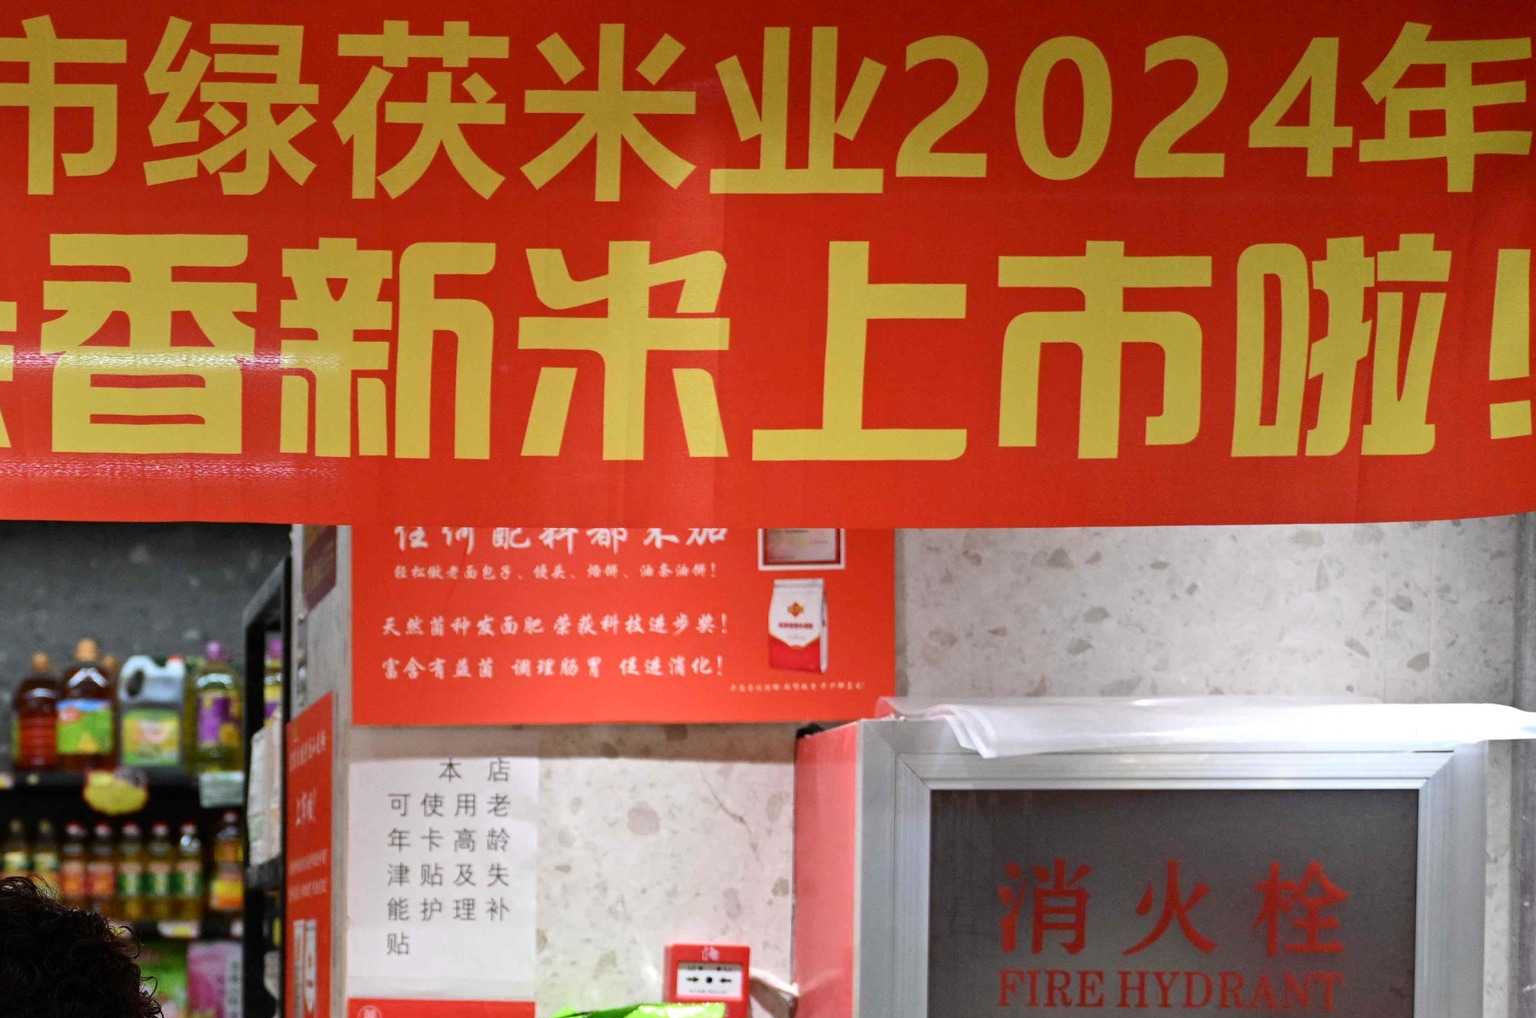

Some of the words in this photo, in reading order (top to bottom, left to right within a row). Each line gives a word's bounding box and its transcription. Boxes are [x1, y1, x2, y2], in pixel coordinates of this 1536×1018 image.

[438, 757, 511, 783] 本店
[387, 793, 511, 818] 可使用老
[387, 827, 510, 852] 年卡高龄
[386, 862, 510, 888] 津贴及失
[386, 897, 511, 922] 能护理补
[996, 857, 1349, 958] 消火栓
[386, 931, 410, 956] 贴
[997, 969, 1105, 1008] FIRE
[1116, 969, 1345, 1013] HYDRANT
